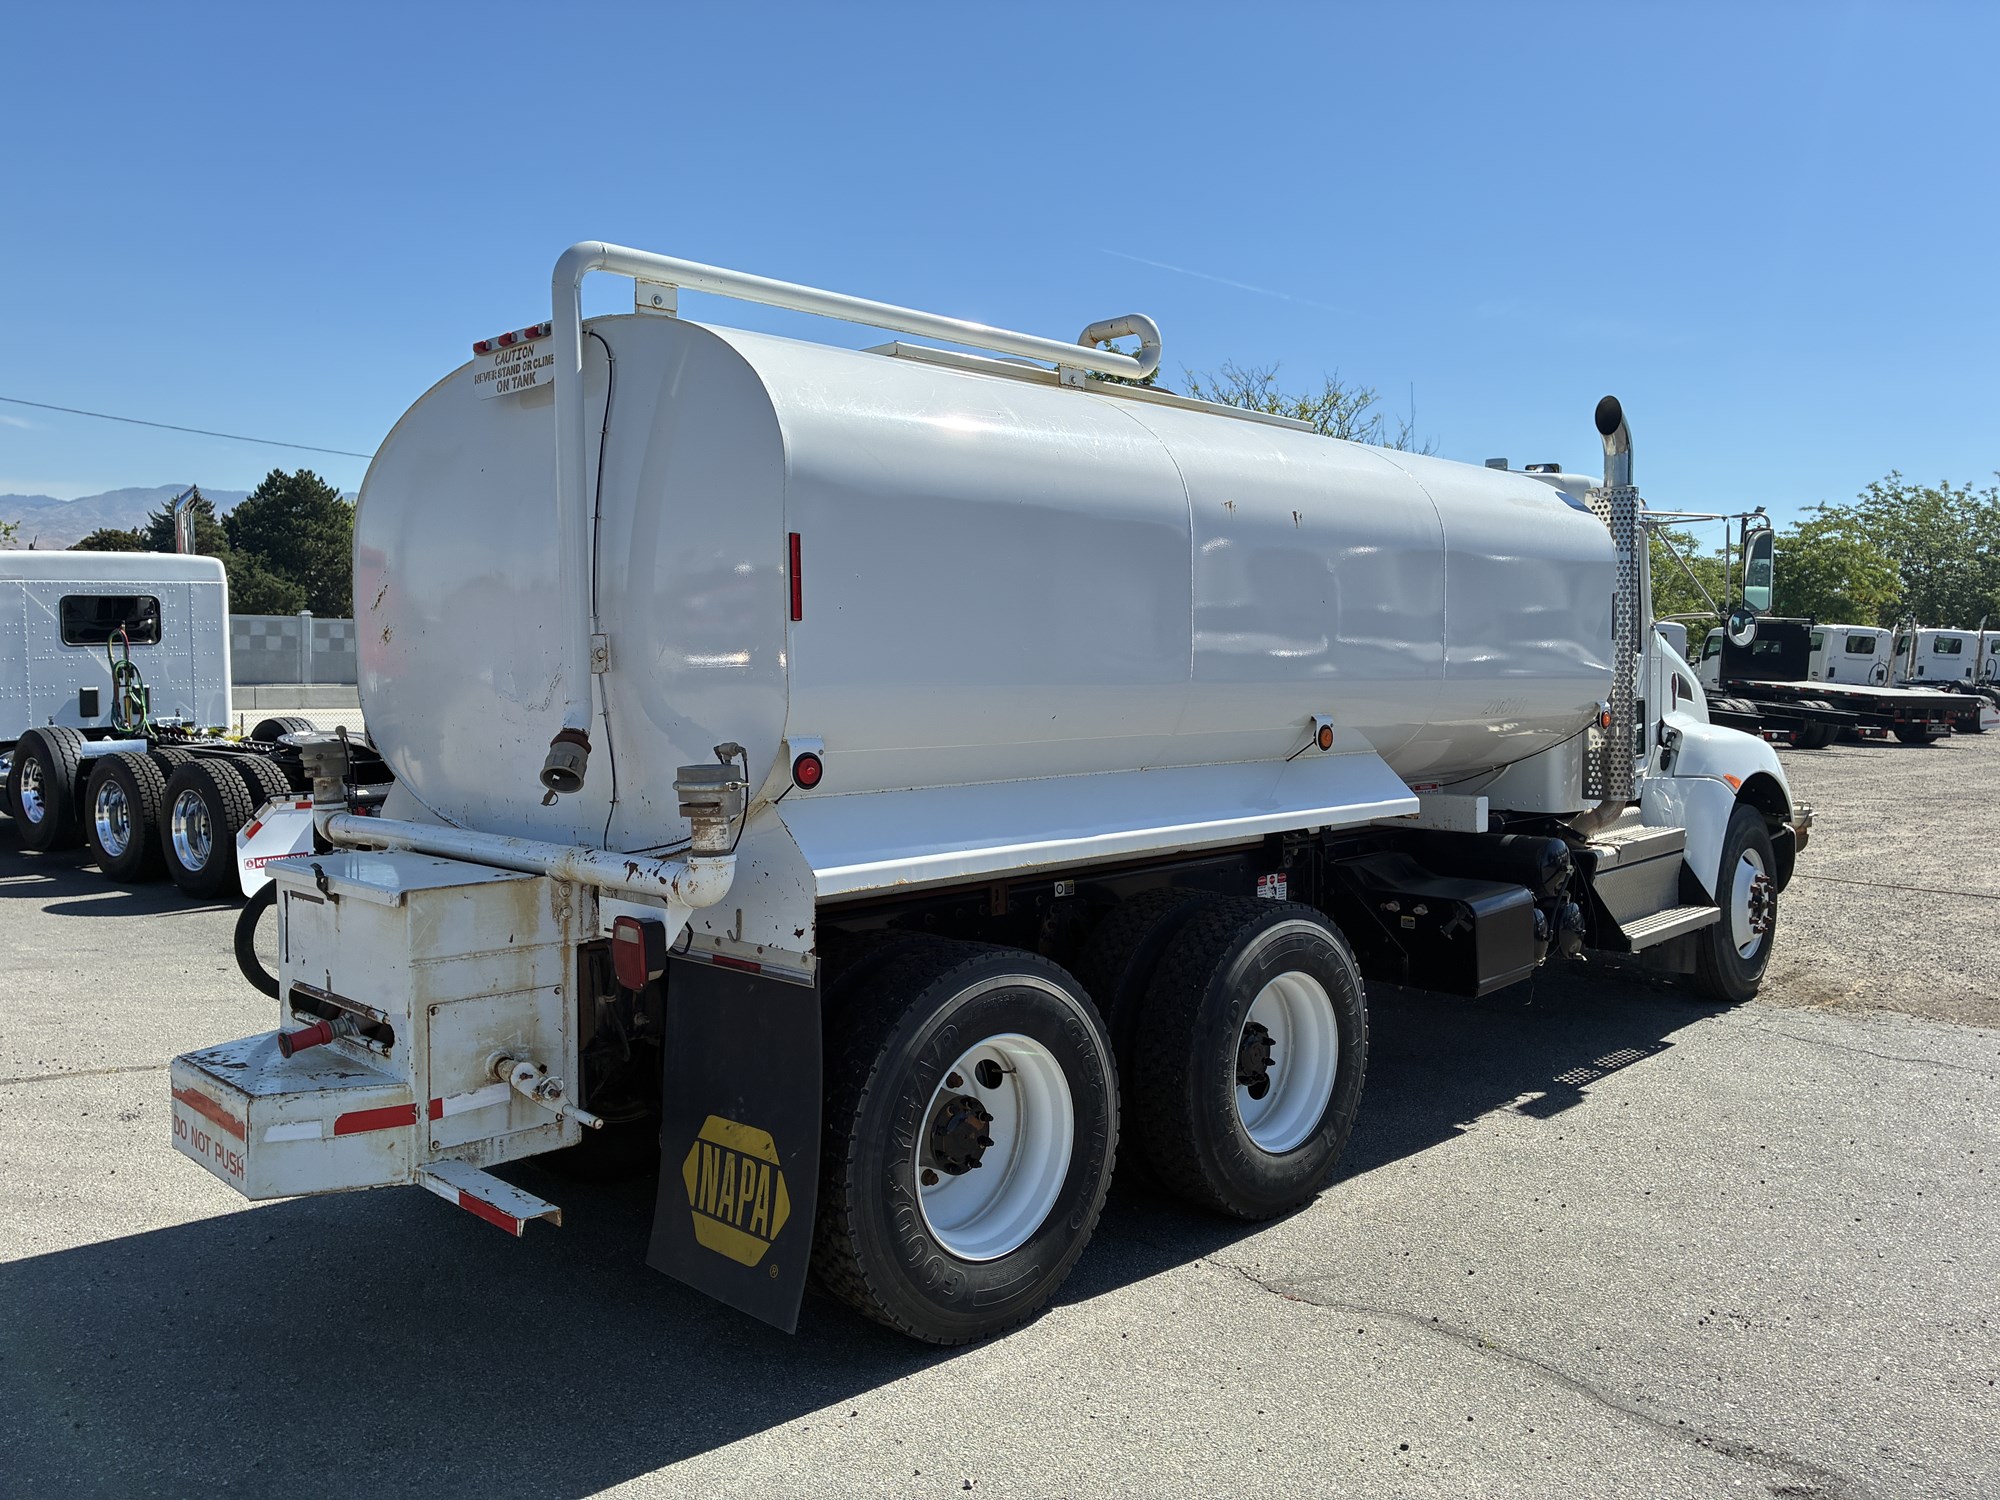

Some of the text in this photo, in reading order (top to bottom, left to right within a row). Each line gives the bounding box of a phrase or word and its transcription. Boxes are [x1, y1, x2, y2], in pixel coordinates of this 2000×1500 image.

[495, 344, 534, 367] CAUTION
[474, 370, 497, 385] NEVER
[498, 364, 521, 379] STAND
[522, 361, 532, 372] OR
[497, 372, 536, 393] ON TANK
[173, 1114, 244, 1181] DO NOT PUSH
[698, 1143, 771, 1237] NAPA
